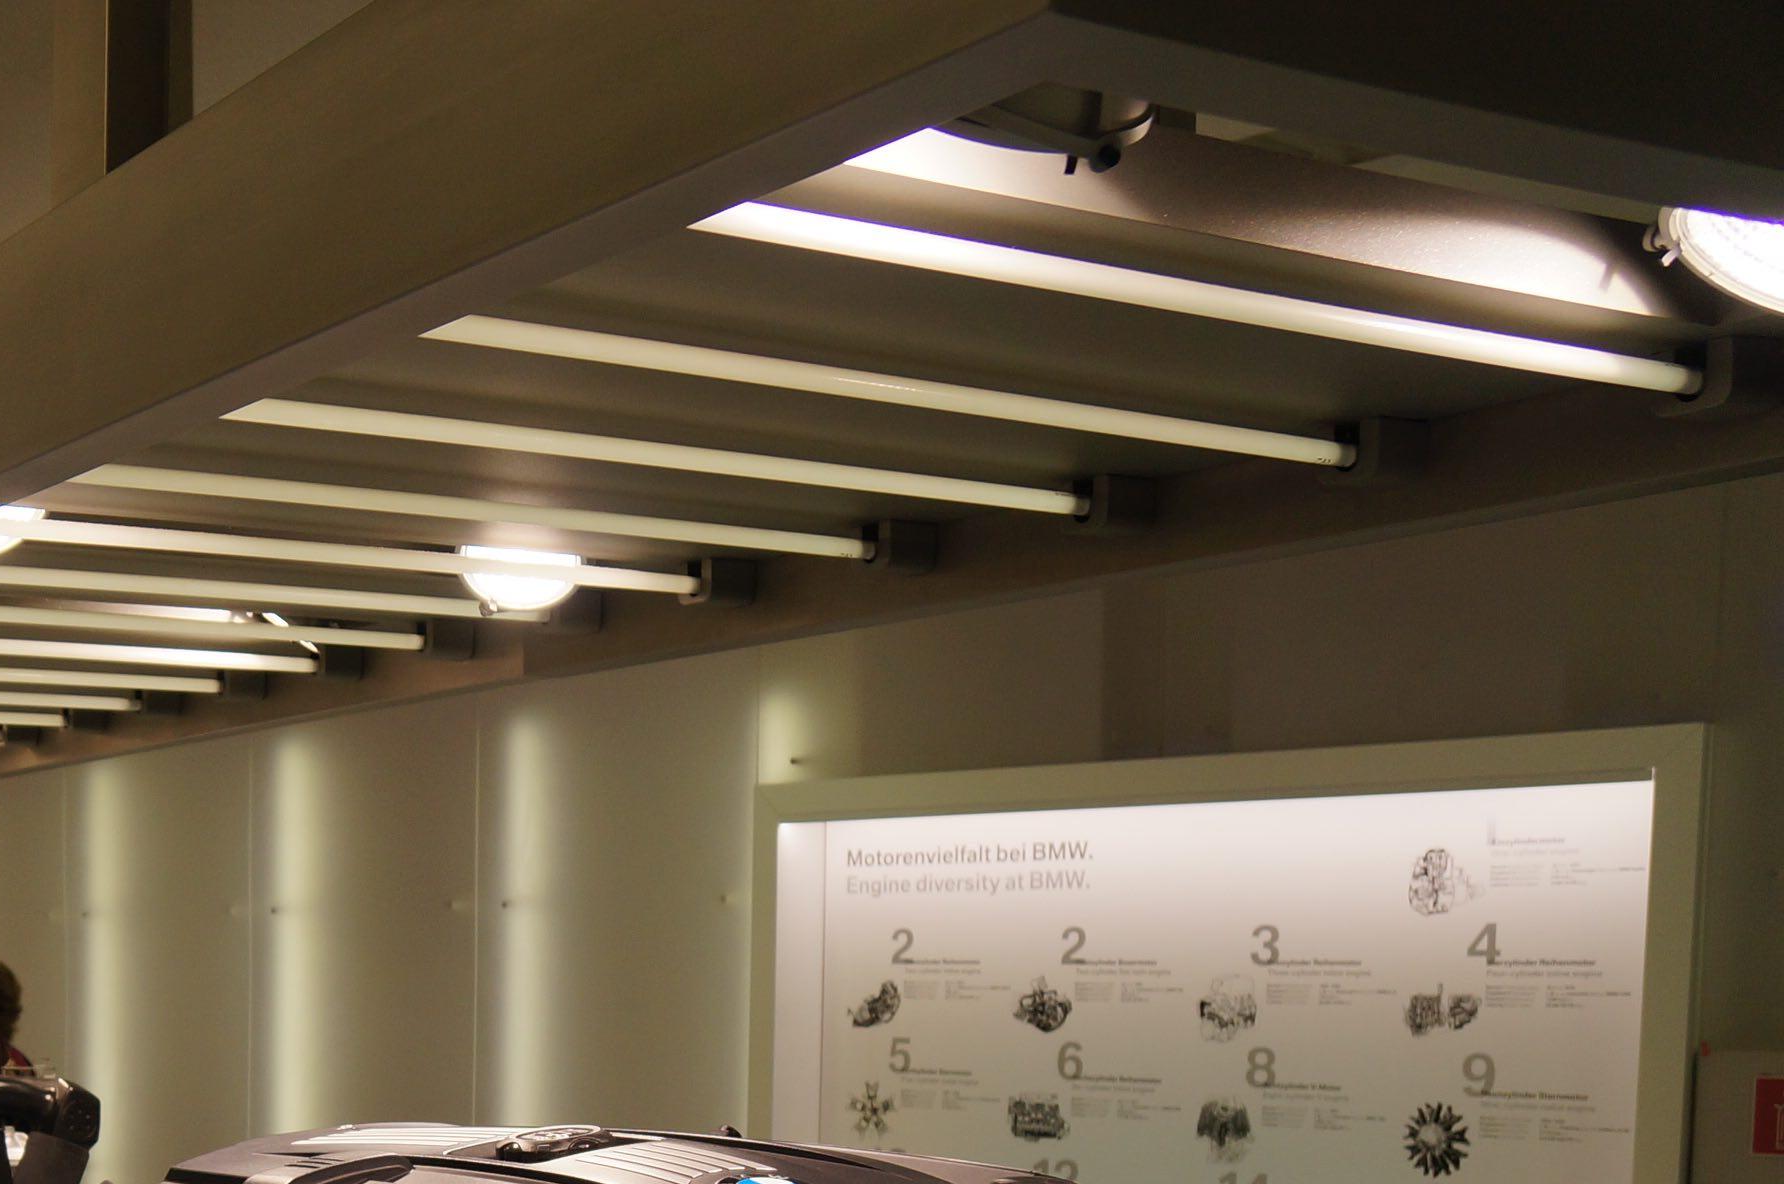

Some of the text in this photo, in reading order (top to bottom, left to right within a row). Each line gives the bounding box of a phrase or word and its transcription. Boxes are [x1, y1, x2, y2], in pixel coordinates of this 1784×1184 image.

[846, 841, 1094, 868] Motorenvielfalt bei BMW.
[846, 871, 1091, 898] Engine diversity at BMW.
[891, 927, 916, 965] 2
[1060, 926, 1088, 965] 2
[1250, 924, 1280, 967] 3
[1466, 923, 1501, 966] 4
[888, 1036, 911, 1073] 5
[1056, 1041, 1084, 1080] 6
[1245, 1046, 1276, 1088] 8
[1462, 1052, 1497, 1097] 9
